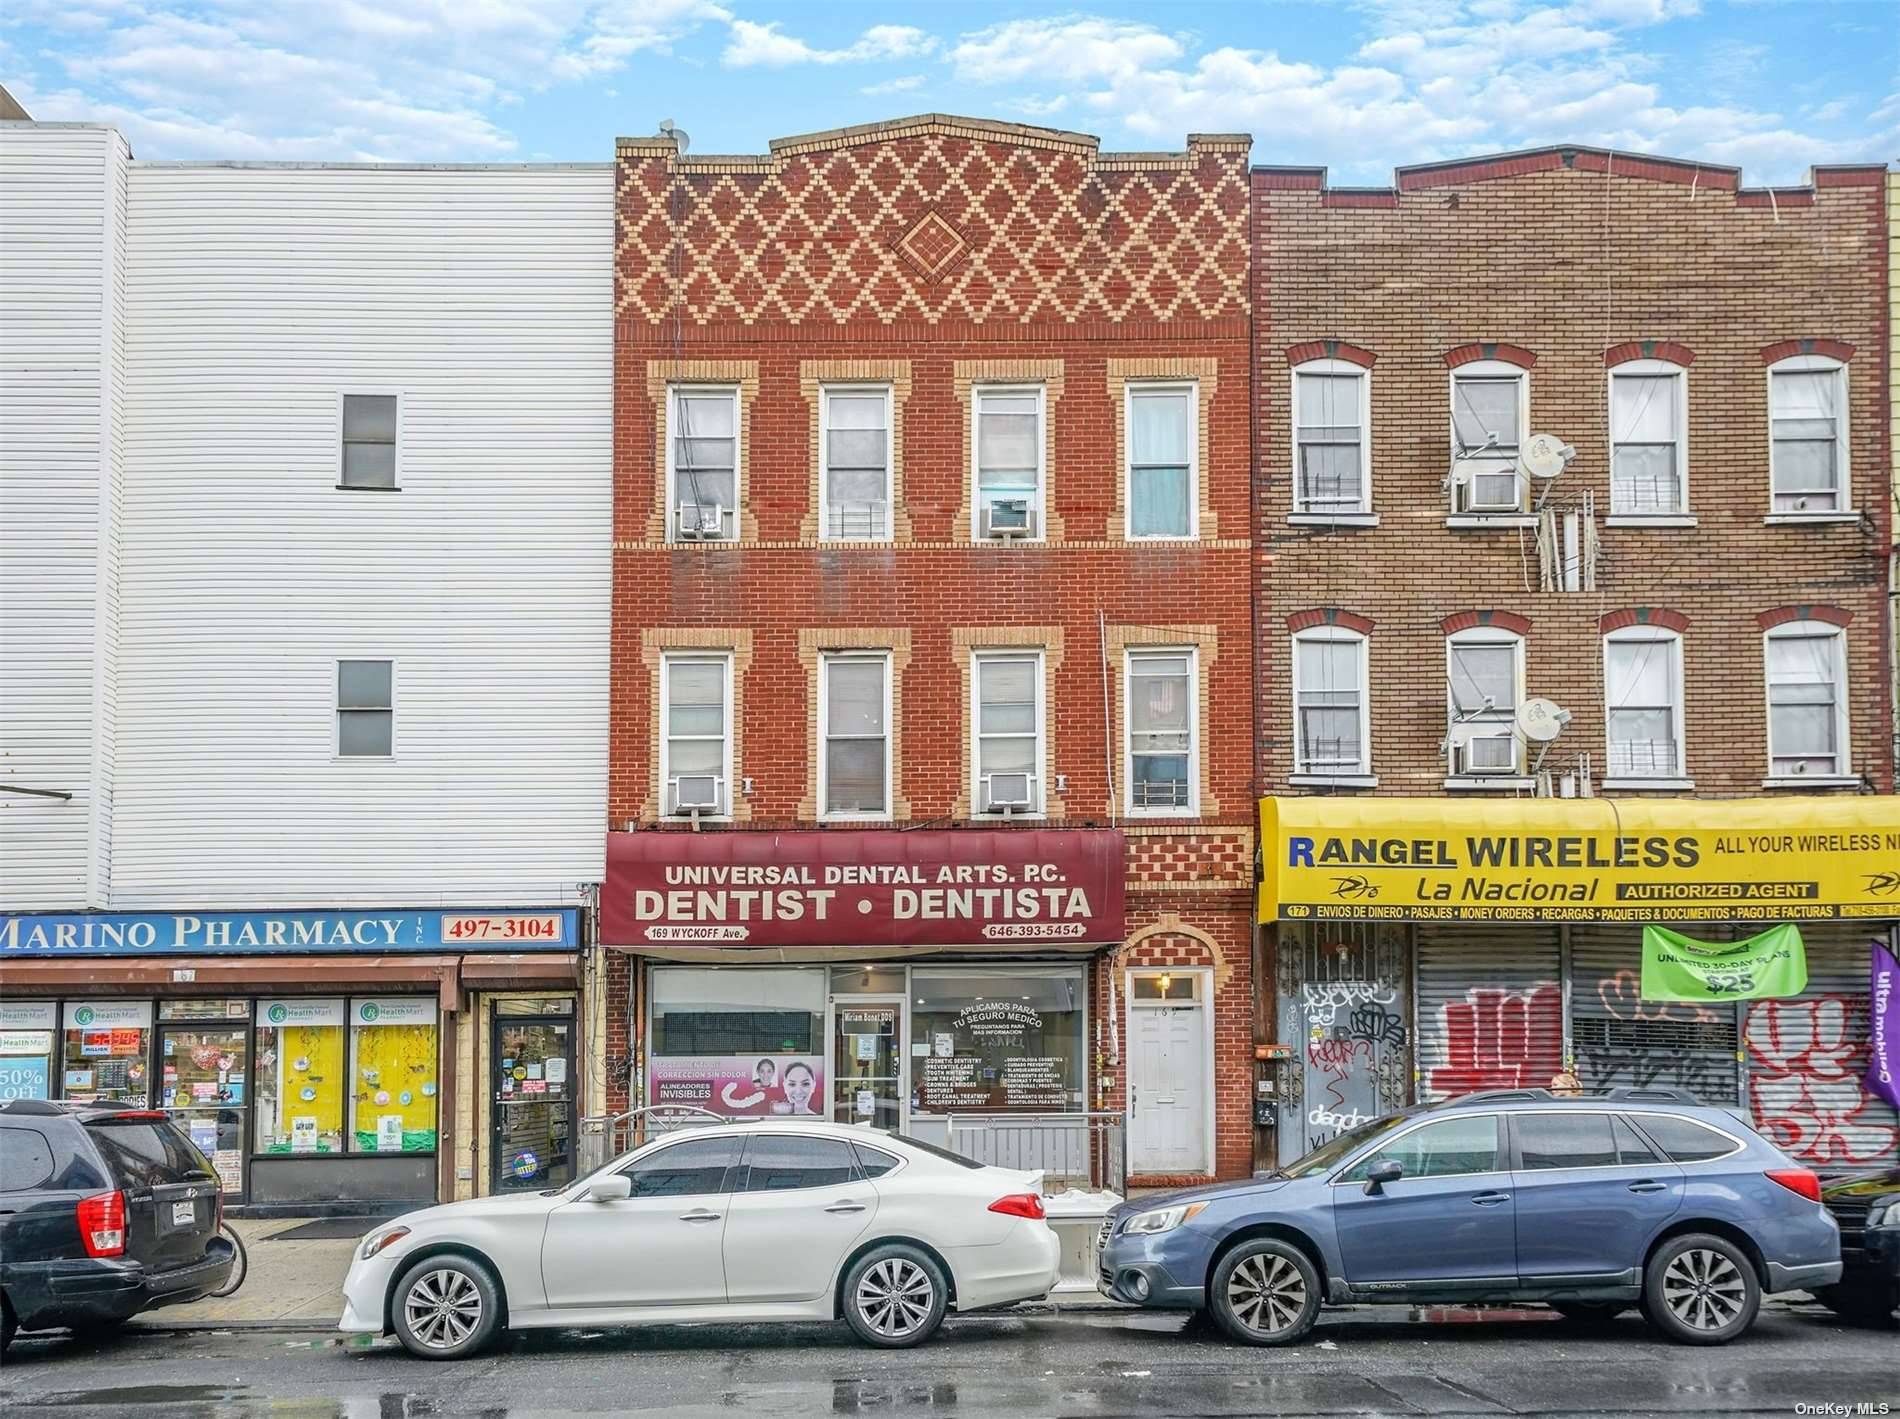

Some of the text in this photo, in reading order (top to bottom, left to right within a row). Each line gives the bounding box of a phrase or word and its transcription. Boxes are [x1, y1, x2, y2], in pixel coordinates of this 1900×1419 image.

[1289, 836, 1700, 867] RANGEL WIRELESS
[1714, 837, 1744, 854] ALL
[1747, 835, 1793, 853] YOUR
[1799, 834, 1880, 852] WIRELESS
[665, 866, 816, 885] UNIVERSAL
[824, 865, 928, 885] DENTAL
[1024, 864, 1066, 883] P.C.
[1416, 877, 1599, 901] La Nacional
[1624, 884, 1811, 898] AUTHORIZED AGENT
[635, 888, 1093, 921] DENTIST DENTISTA
[1290, 907, 1306, 916] 171
[1317, 906, 1351, 918] ENVIOS
[1353, 906, 1367, 918] DE
[1368, 906, 1403, 918] DINERO
[1410, 906, 1452, 918] PASAJES
[1460, 906, 1494, 919] MONEY
[1495, 906, 1534, 919] ORDERS
[1542, 907, 1594, 920] RECARGAS
[1601, 908, 1652, 920] PAQUETES
[1654, 908, 1661, 920] &
[1662, 907, 1729, 920] DOCUMENTOS
[1737, 906, 1762, 918] PAGO
[1766, 906, 1780, 918] DE
[1782, 905, 1833, 918] FACTURAS
[172, 916, 404, 946] PHARMACY
[450, 919, 554, 938] 497-3104
[651, 927, 744, 939] 169 WYCKOFF Ave.
[988, 924, 1080, 937] 646-393-5454
[1657, 953, 1710, 969] UNLIMITED
[1714, 959, 1753, 970] 30-DAY
[1706, 974, 1755, 995] $25
[960, 1002, 1010, 1017] APLICAMOS
[953, 1012, 1042, 1029] TU SEGURO MEDICO
[0, 1069, 42, 1085] 50%
[4, 1088, 37, 1100] OFF
[660, 1090, 711, 1099] INVISIBLES
